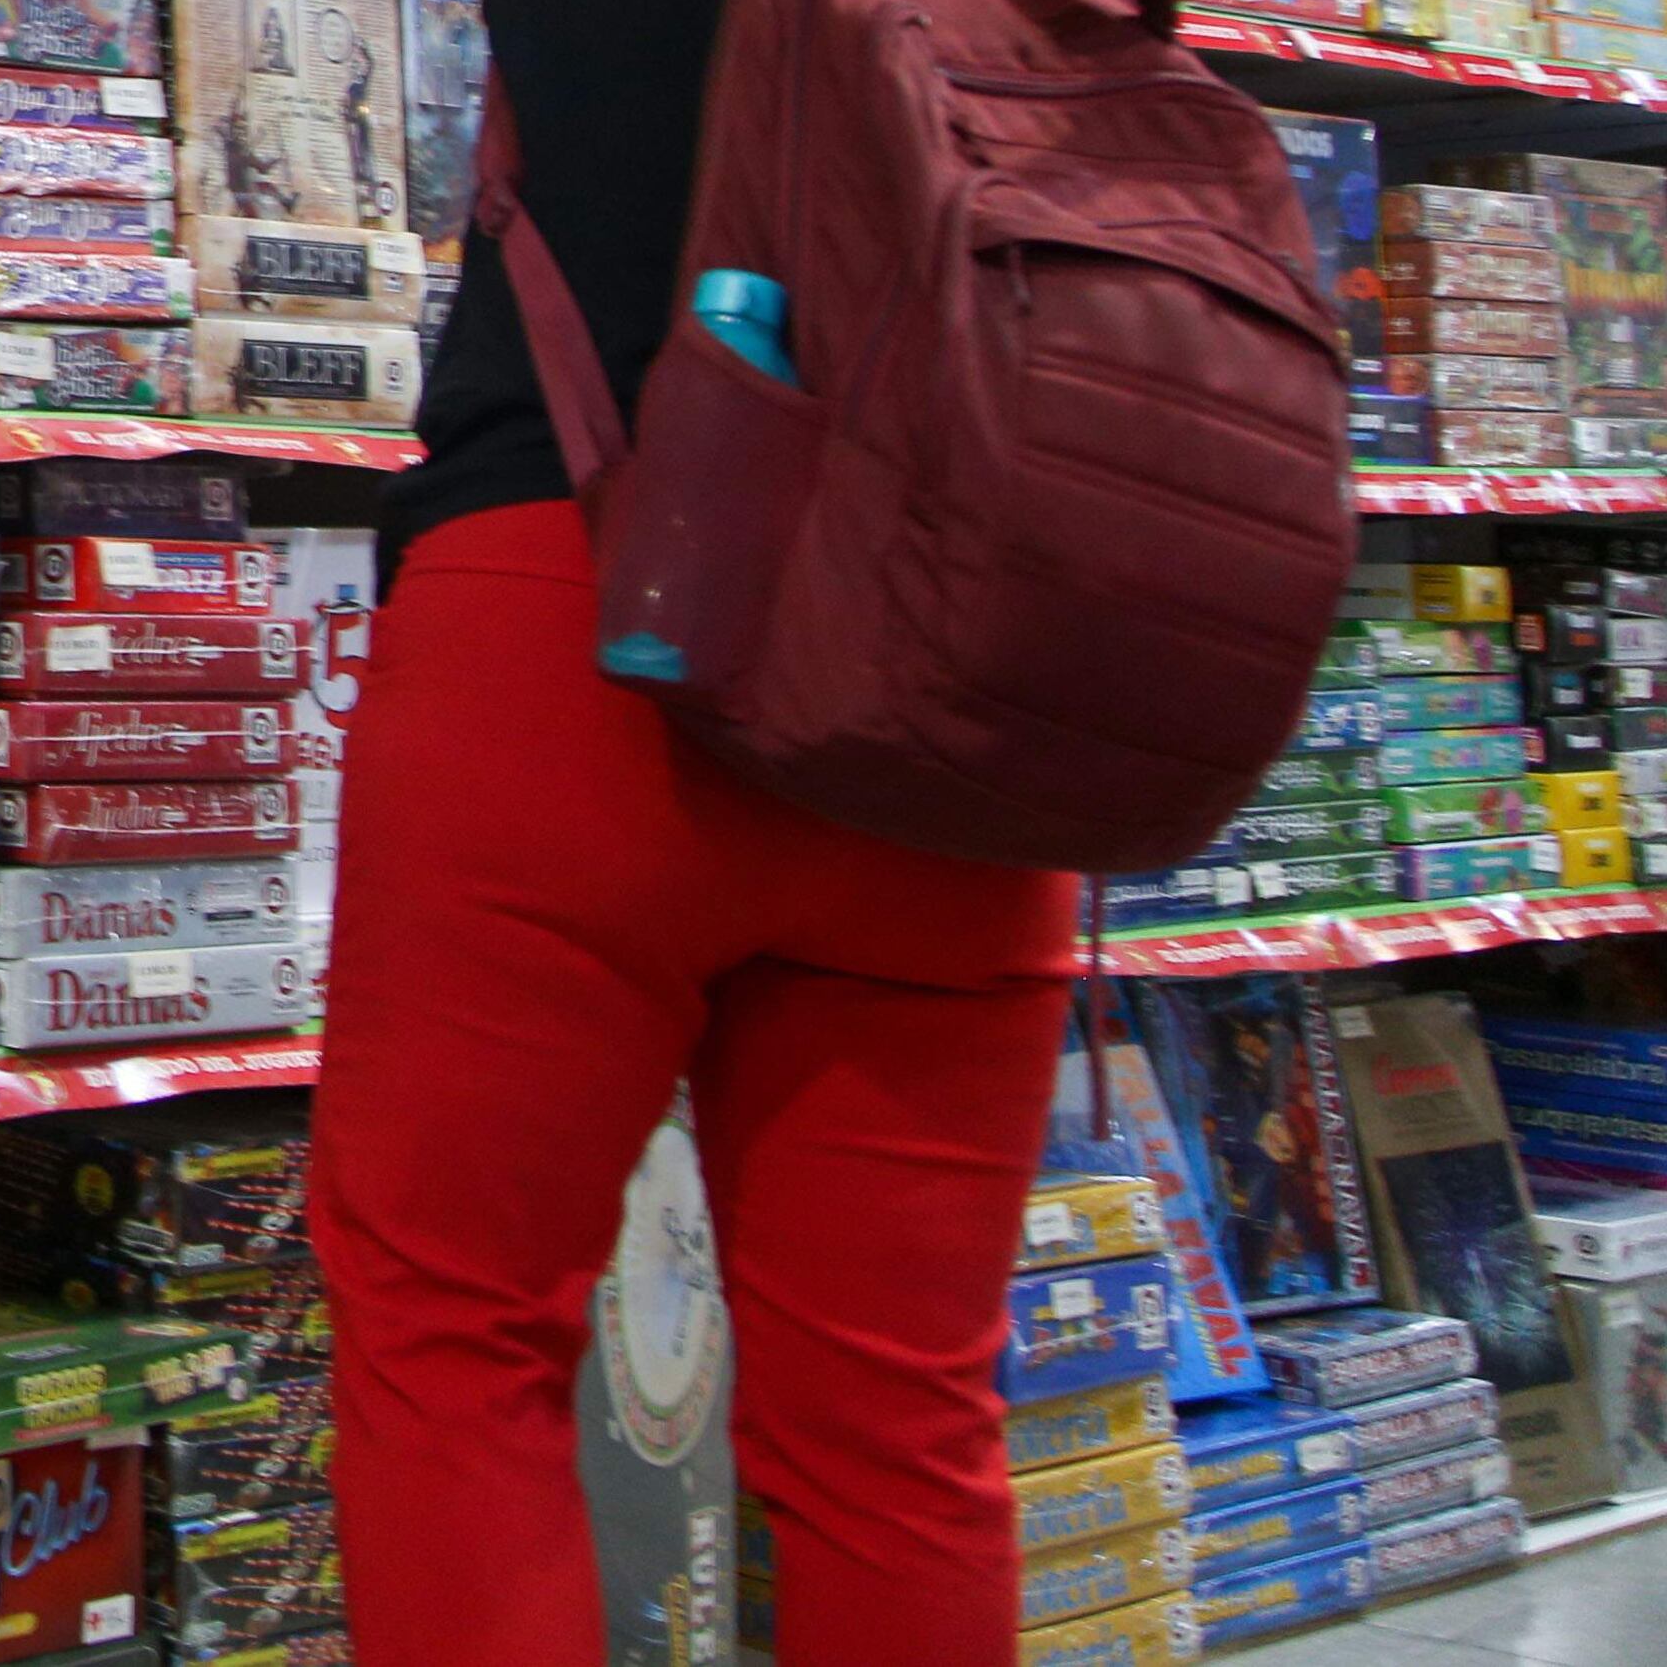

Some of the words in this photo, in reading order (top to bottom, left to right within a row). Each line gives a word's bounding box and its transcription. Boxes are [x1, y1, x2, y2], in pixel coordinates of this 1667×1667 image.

[252, 242, 366, 293] BLEFF
[250, 345, 366, 391] BLEFF
[42, 889, 178, 946] Damas
